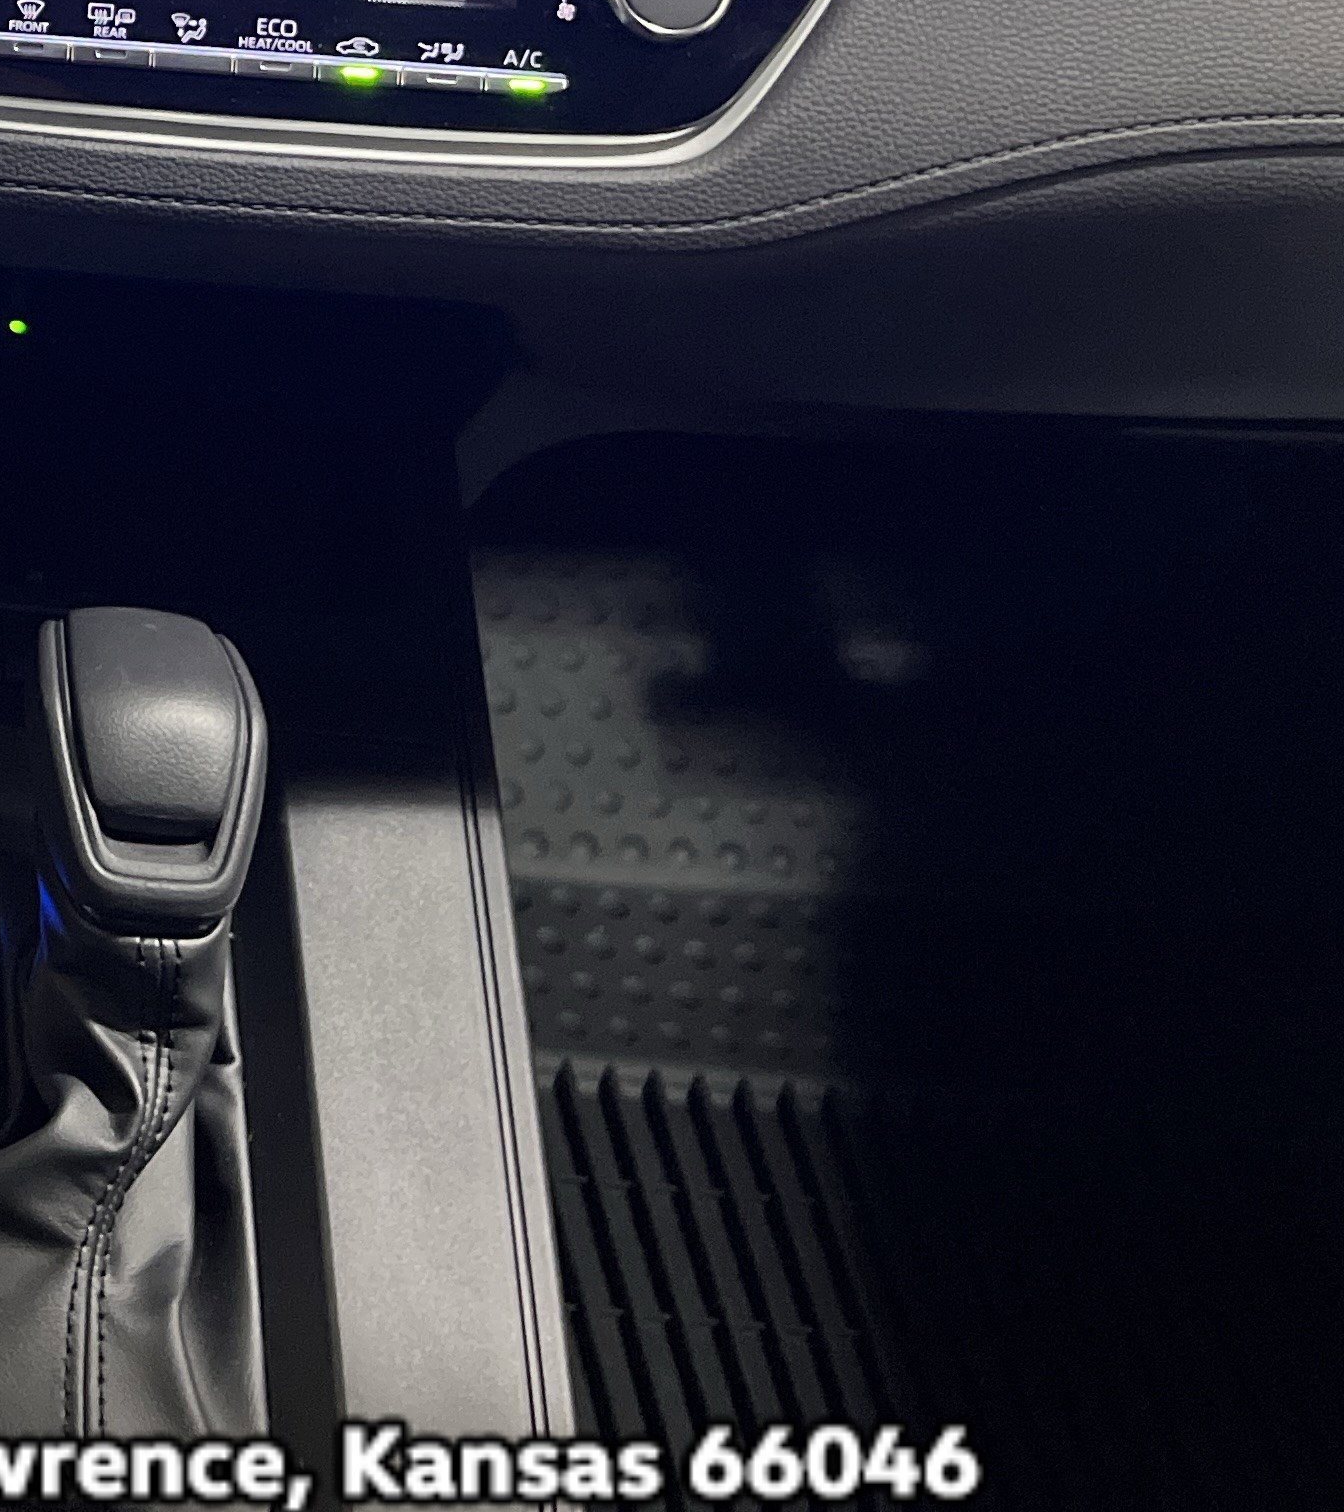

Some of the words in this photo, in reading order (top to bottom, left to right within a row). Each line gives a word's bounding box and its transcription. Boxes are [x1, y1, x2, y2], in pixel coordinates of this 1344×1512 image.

[8, 18, 50, 34] FRONT
[93, 24, 128, 40] REAR
[256, 17, 299, 39] ECO
[238, 35, 313, 54] HEAT/COOL
[503, 49, 544, 70] A/C
